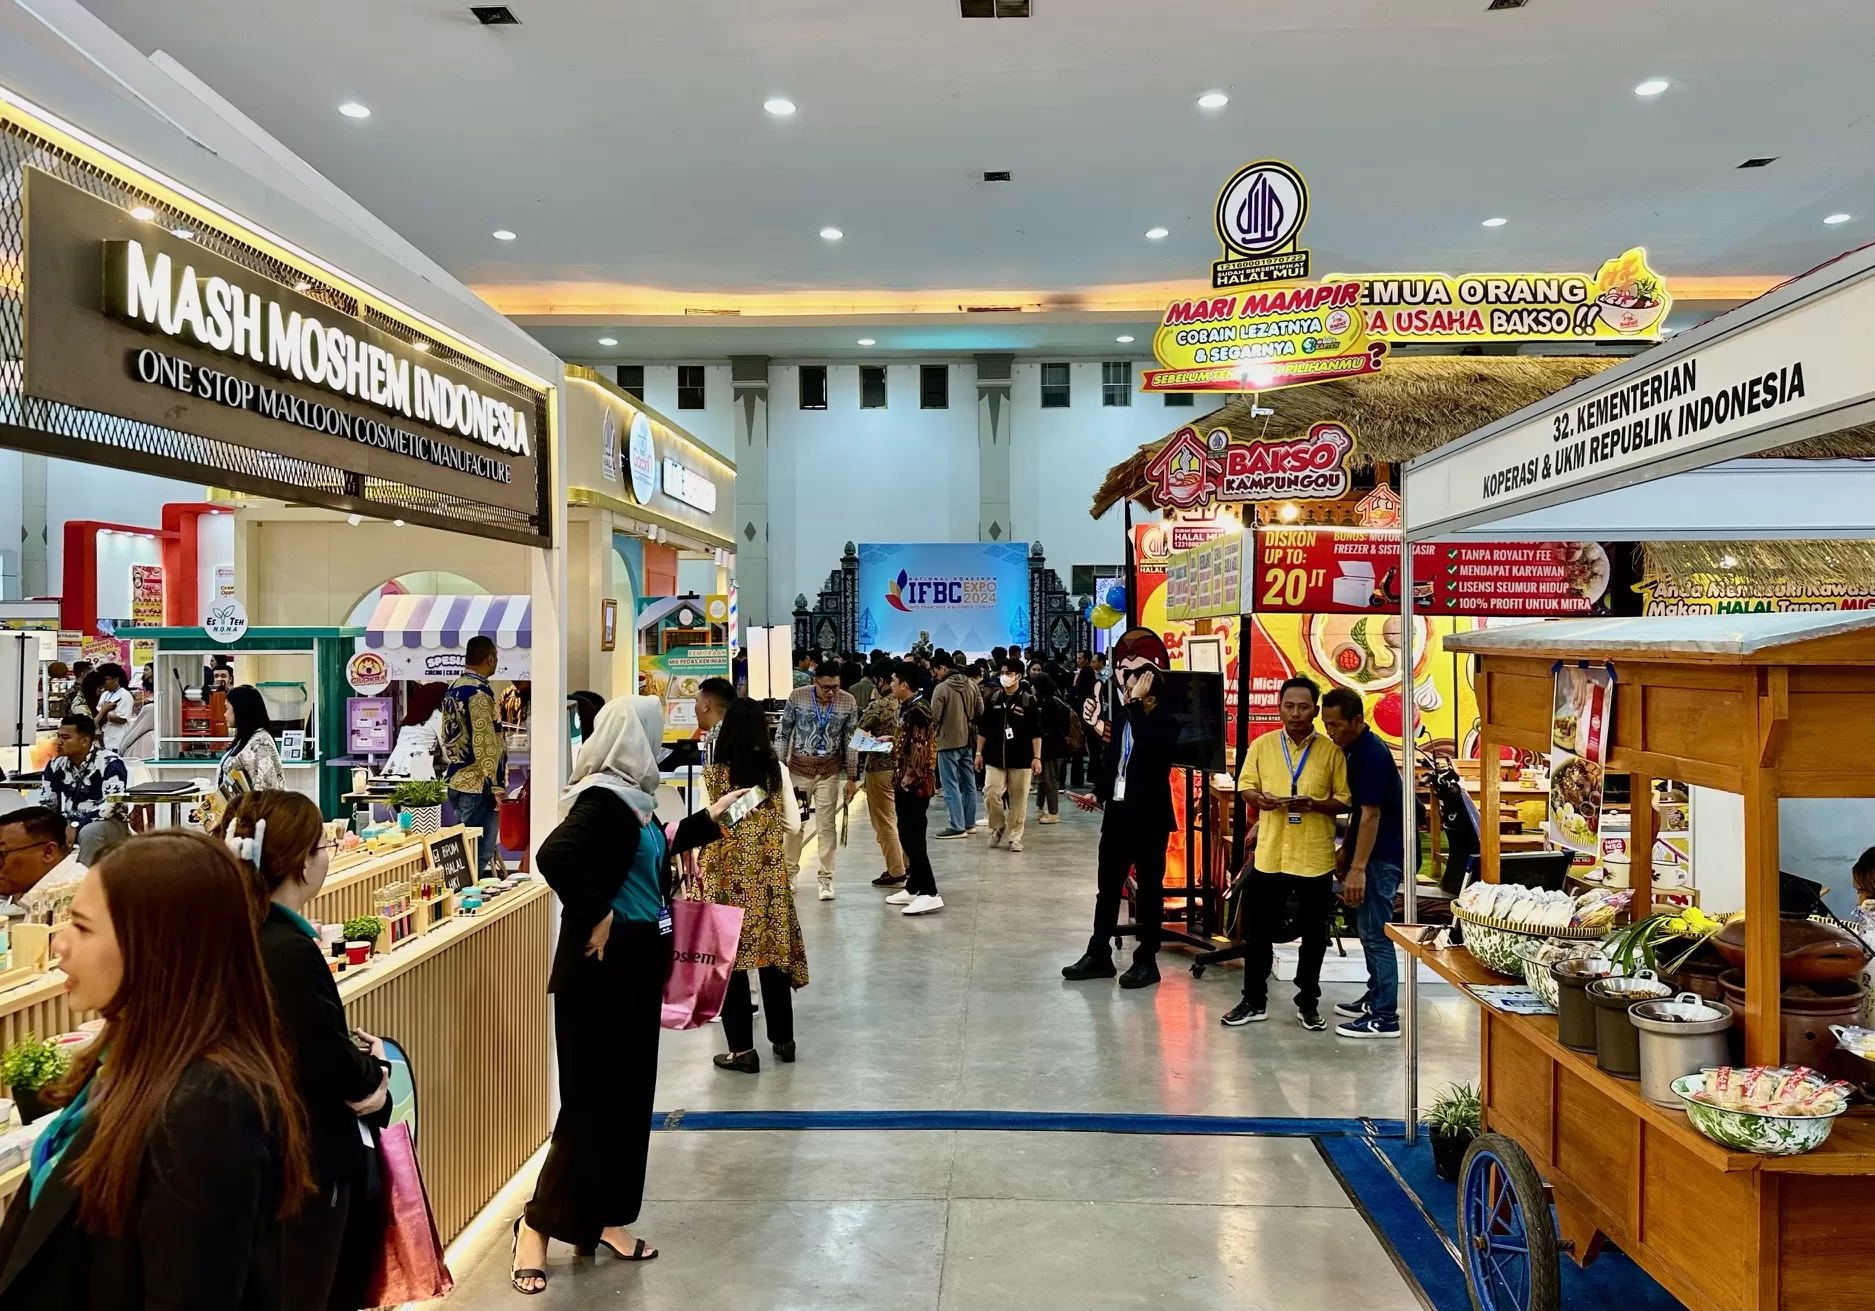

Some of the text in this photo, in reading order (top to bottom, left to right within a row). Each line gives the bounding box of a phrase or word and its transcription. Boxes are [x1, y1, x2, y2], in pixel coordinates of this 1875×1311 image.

[1217, 268, 1304, 285] HALAL MUI
[1246, 262, 1304, 274] BERSERTIFIKAT
[1459, 280, 1587, 304] ORANG
[1164, 282, 1361, 325] MARI MAMPIR
[1395, 311, 1483, 333] USAHA
[1492, 311, 1568, 333] BAKSO
[1176, 318, 1321, 345] COBAIN LEZATNYA
[127, 239, 530, 457] MASH MOSHEM INDONESIA
[1194, 341, 1295, 363] & SEGARNYA
[1153, 371, 1209, 385] SEBELUM
[1281, 357, 1364, 375] PILIHANMU
[1367, 341, 1388, 368] ?
[1553, 358, 1698, 443] 32. KEMENTERIAN
[138, 349, 511, 484] ONE STOP MAKLOON COSMETIC MANUFACTURE
[1482, 361, 1806, 499] KOPERASI & UKM REPUBLIK INDONESIA
[1228, 443, 1337, 476] BAKSO
[1225, 474, 1340, 492] KAMPUNGQU
[1265, 532, 1316, 547] DISKON
[1334, 532, 1367, 541] BONUS:
[1265, 550, 1307, 564] UP TO:
[1334, 544, 1369, 554] FREEZER
[1370, 544, 1376, 554] &
[1461, 550, 1551, 561] TANPA ROYALTY FEE
[1460, 566, 1564, 577] MENDAPAT KARYAWAN
[909, 582, 997, 603] IFBC EXPO
[1263, 568, 1326, 606] 20 JT
[1459, 582, 1569, 593] LISENSI SEUMUR HIDUP
[1653, 581, 1700, 598] Anda
[964, 593, 996, 603] 2024
[1459, 598, 1591, 610] 100% PROFIT UNTUK MITRA
[1648, 601, 1712, 616] Makan
[1717, 600, 1776, 614] HALAL
[1777, 600, 1836, 613] Tanpa
[445, 858, 465, 875] HALAL
